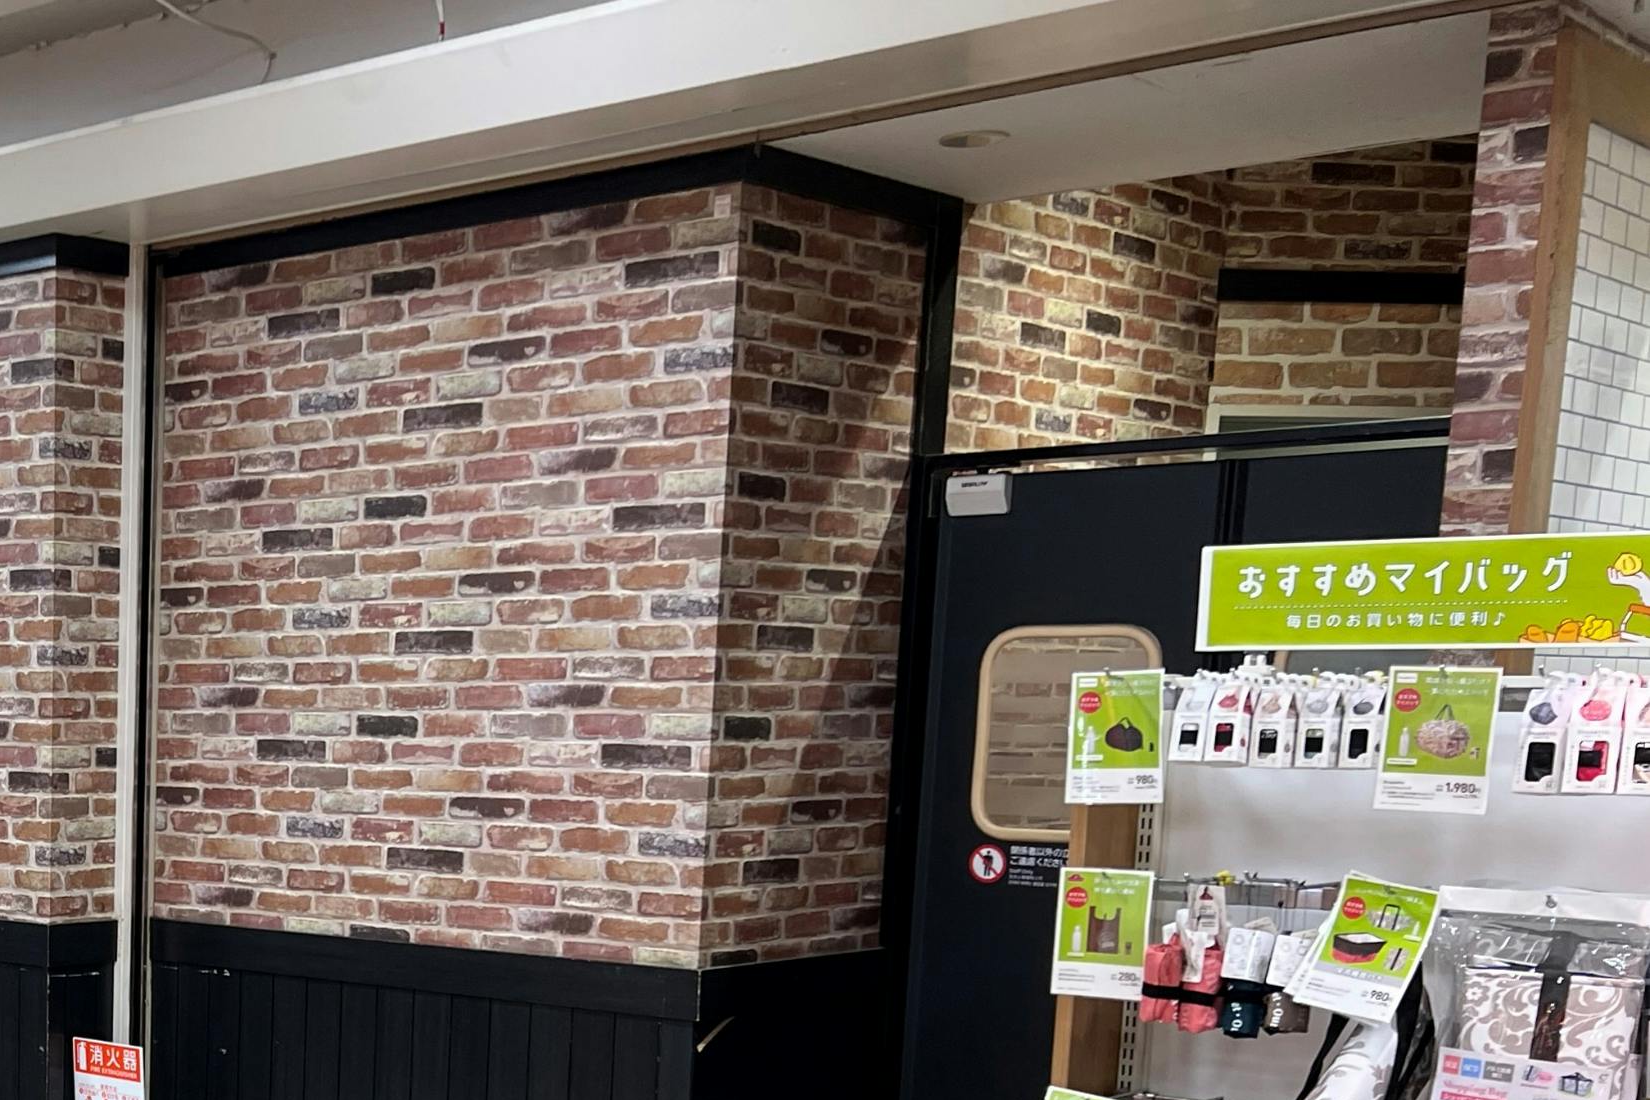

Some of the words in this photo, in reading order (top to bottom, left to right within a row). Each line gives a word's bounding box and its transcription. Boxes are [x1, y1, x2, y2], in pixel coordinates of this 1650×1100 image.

[1238, 552, 1572, 599] おすすめマイバッグ
[90, 1045, 137, 1072] 消火器
